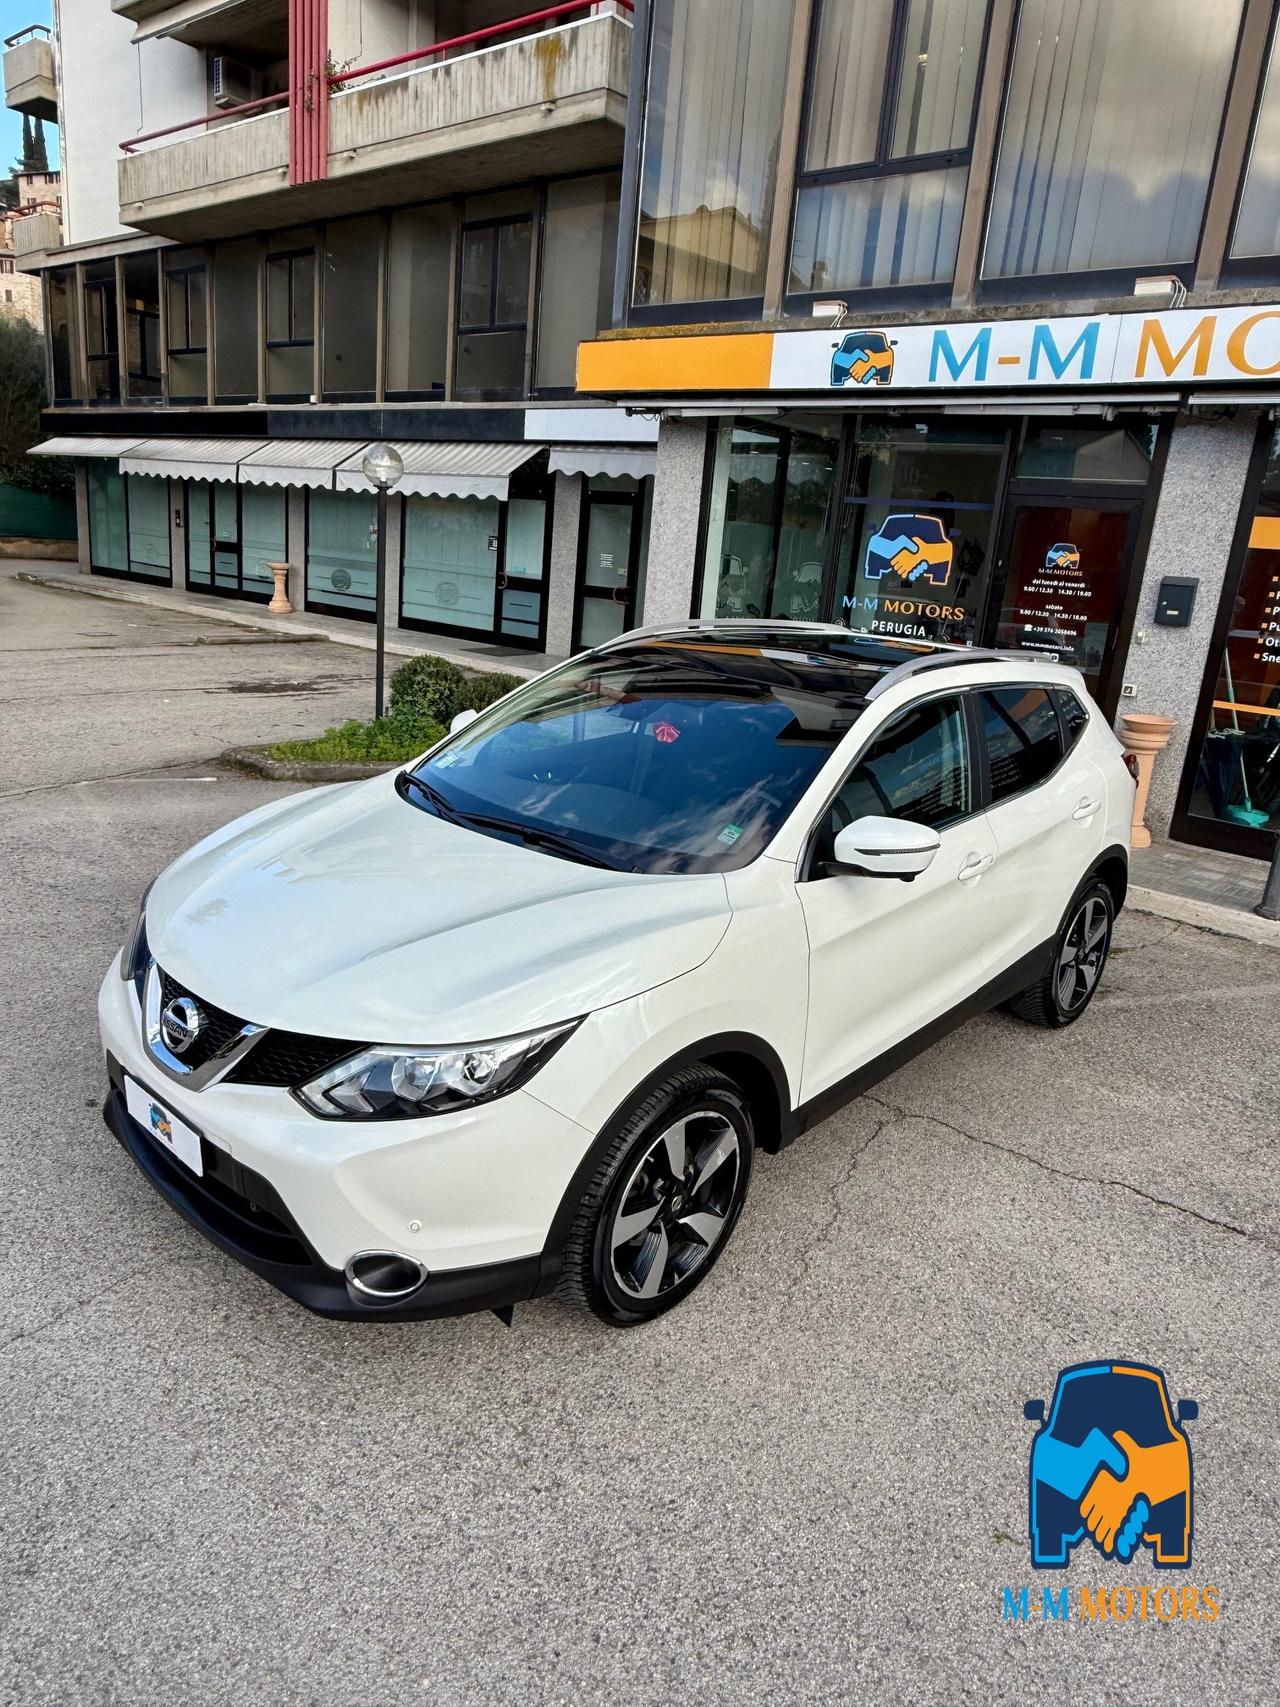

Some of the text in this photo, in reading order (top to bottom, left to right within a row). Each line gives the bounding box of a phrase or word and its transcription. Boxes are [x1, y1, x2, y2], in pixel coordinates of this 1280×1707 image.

[928, 311, 1280, 382] M-M MO
[1053, 569, 1083, 577] MOTORS
[842, 595, 965, 620] M-M MOTORS
[871, 620, 926, 636] PERUGIA
